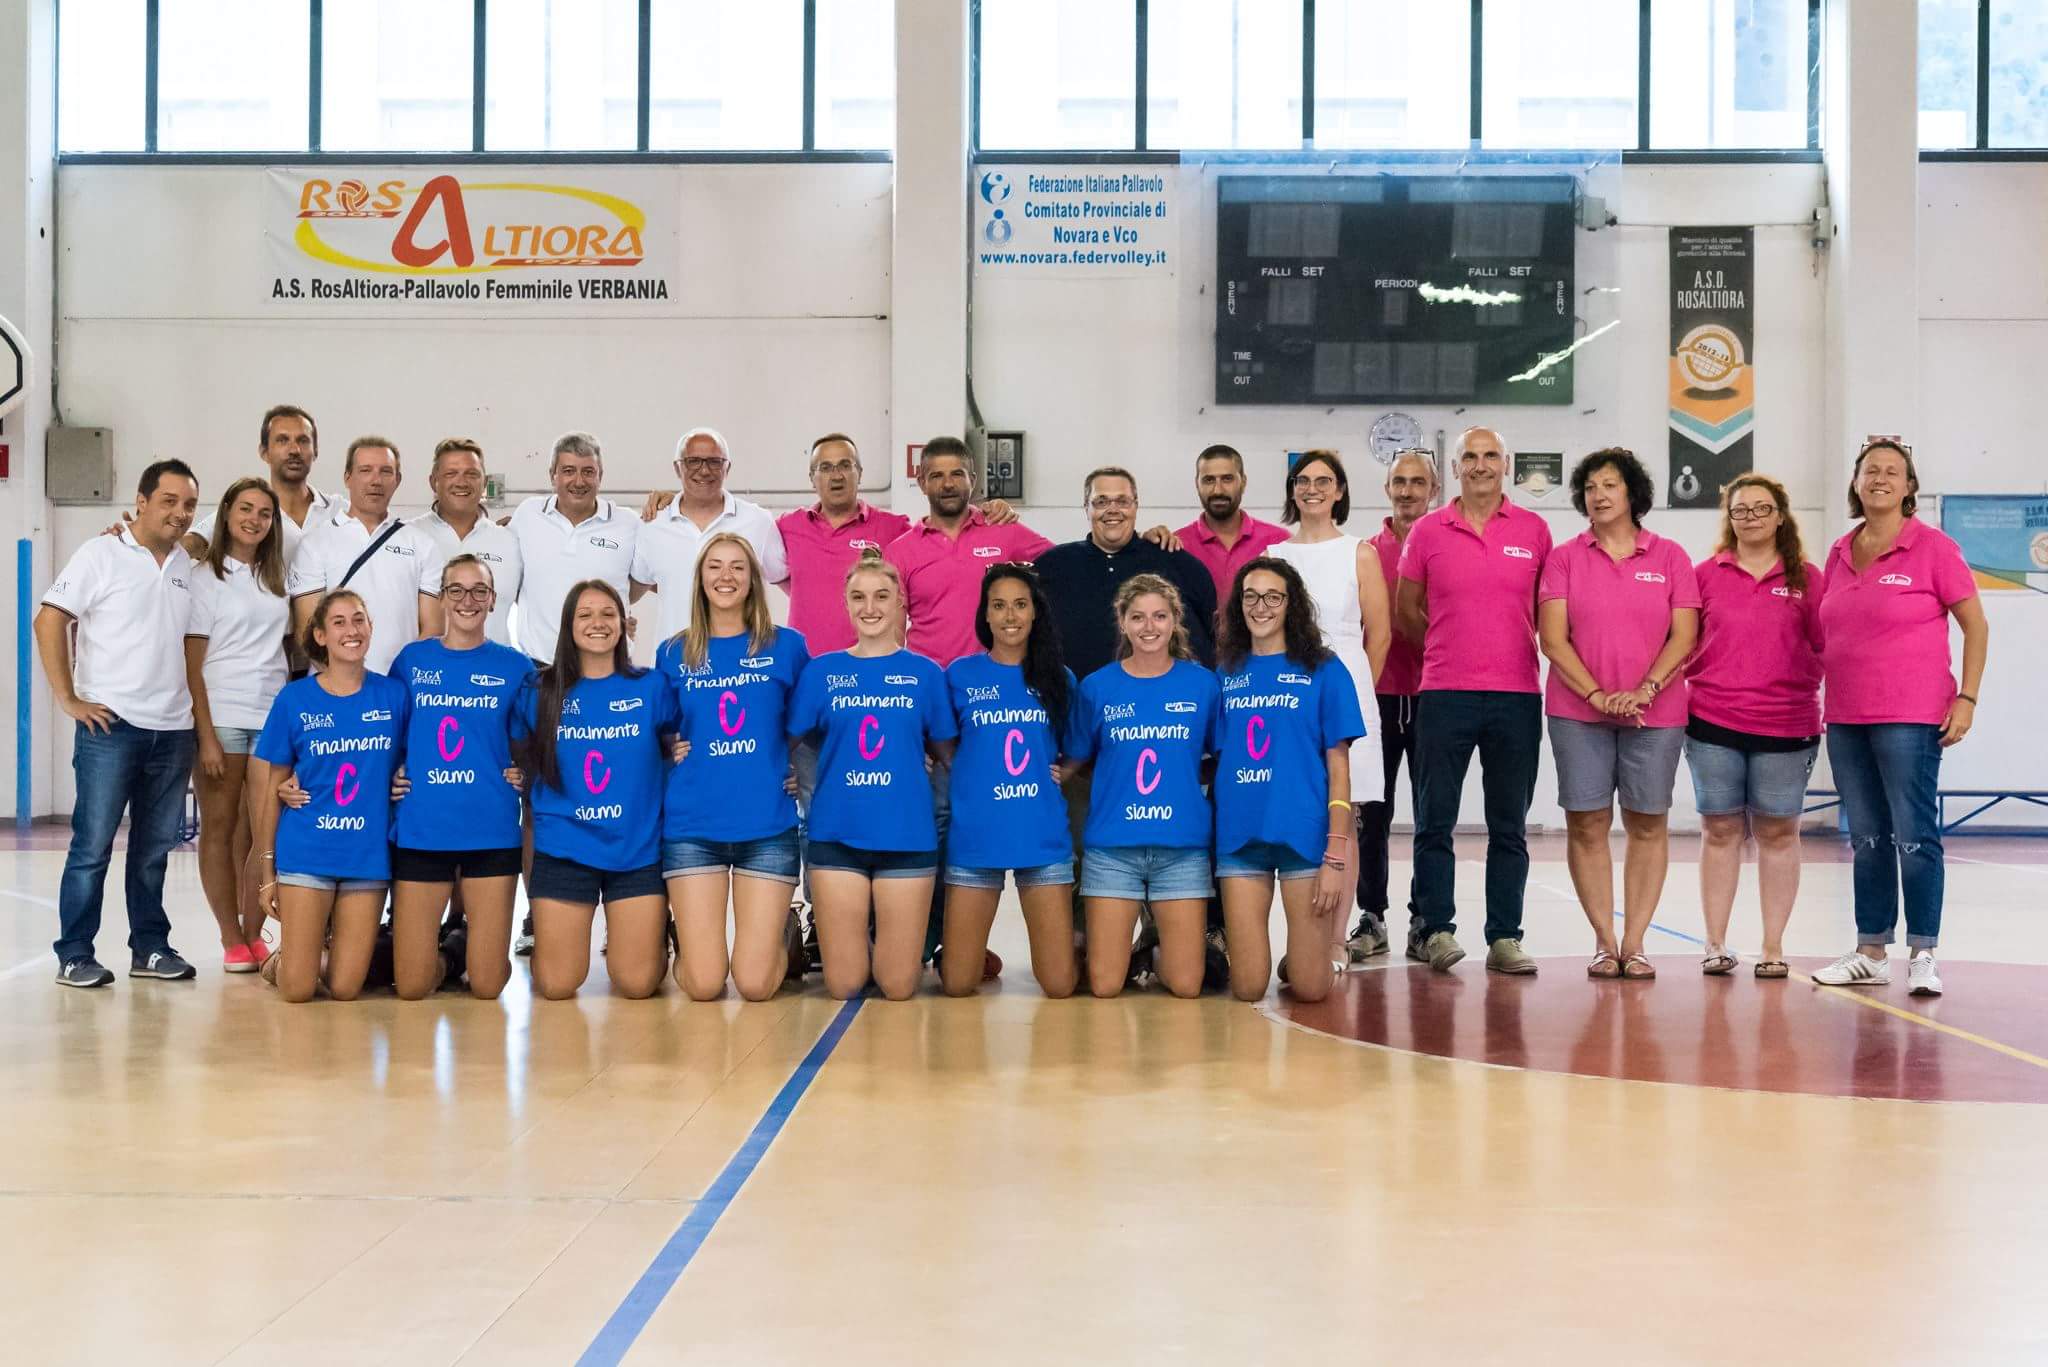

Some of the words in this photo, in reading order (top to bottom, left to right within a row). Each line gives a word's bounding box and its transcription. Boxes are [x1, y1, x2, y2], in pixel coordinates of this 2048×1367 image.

[1029, 174, 1083, 193] Federazione
[1085, 175, 1120, 193] Italiana
[1122, 174, 1164, 193] Pallavolo
[1024, 201, 1080, 218] Comitato
[1083, 201, 1152, 218] Provinciale
[1154, 201, 1167, 218] di
[1053, 226, 1099, 244] Novara
[1102, 230, 1110, 244] e
[1113, 226, 1138, 244] Vco
[980, 250, 1167, 267] www.novara.federvolley.it
[1261, 267, 1291, 277] FALLI
[1301, 266, 1325, 277] SET
[1468, 267, 1498, 277] FALLI
[1509, 265, 1533, 277] SET
[1694, 270, 1728, 289] A.S.D.
[272, 278, 306, 299] A.S.
[311, 278, 481, 299] RosAltiora-Pallavolo
[485, 279, 573, 299] Femminile
[577, 279, 669, 299] VERBANIA
[1374, 279, 1418, 289] PERIODI
[1677, 290, 1745, 309] ROSALTIORA
[1232, 351, 1253, 361] TIME
[1233, 375, 1252, 386] OUT
[1538, 376, 1556, 387] OUT
[684, 672, 770, 692] finalmente
[415, 691, 498, 709] finalmente
[831, 694, 914, 712] finalmente
[718, 690, 746, 736] C
[437, 715, 465, 762] C
[858, 714, 885, 761] C
[1109, 723, 1190, 744] finalmente
[1246, 714, 1271, 761] C
[309, 734, 392, 757] finalmente
[709, 738, 756, 757] siamo
[1004, 729, 1030, 776] C
[427, 767, 475, 785] siamo
[583, 749, 611, 794] C
[846, 769, 892, 787] siamo
[1135, 748, 1162, 795] C
[334, 762, 361, 806] C
[993, 782, 1039, 801] siamo
[575, 803, 622, 821] siamo
[1125, 803, 1173, 821] siamo
[315, 813, 365, 831] siamo
